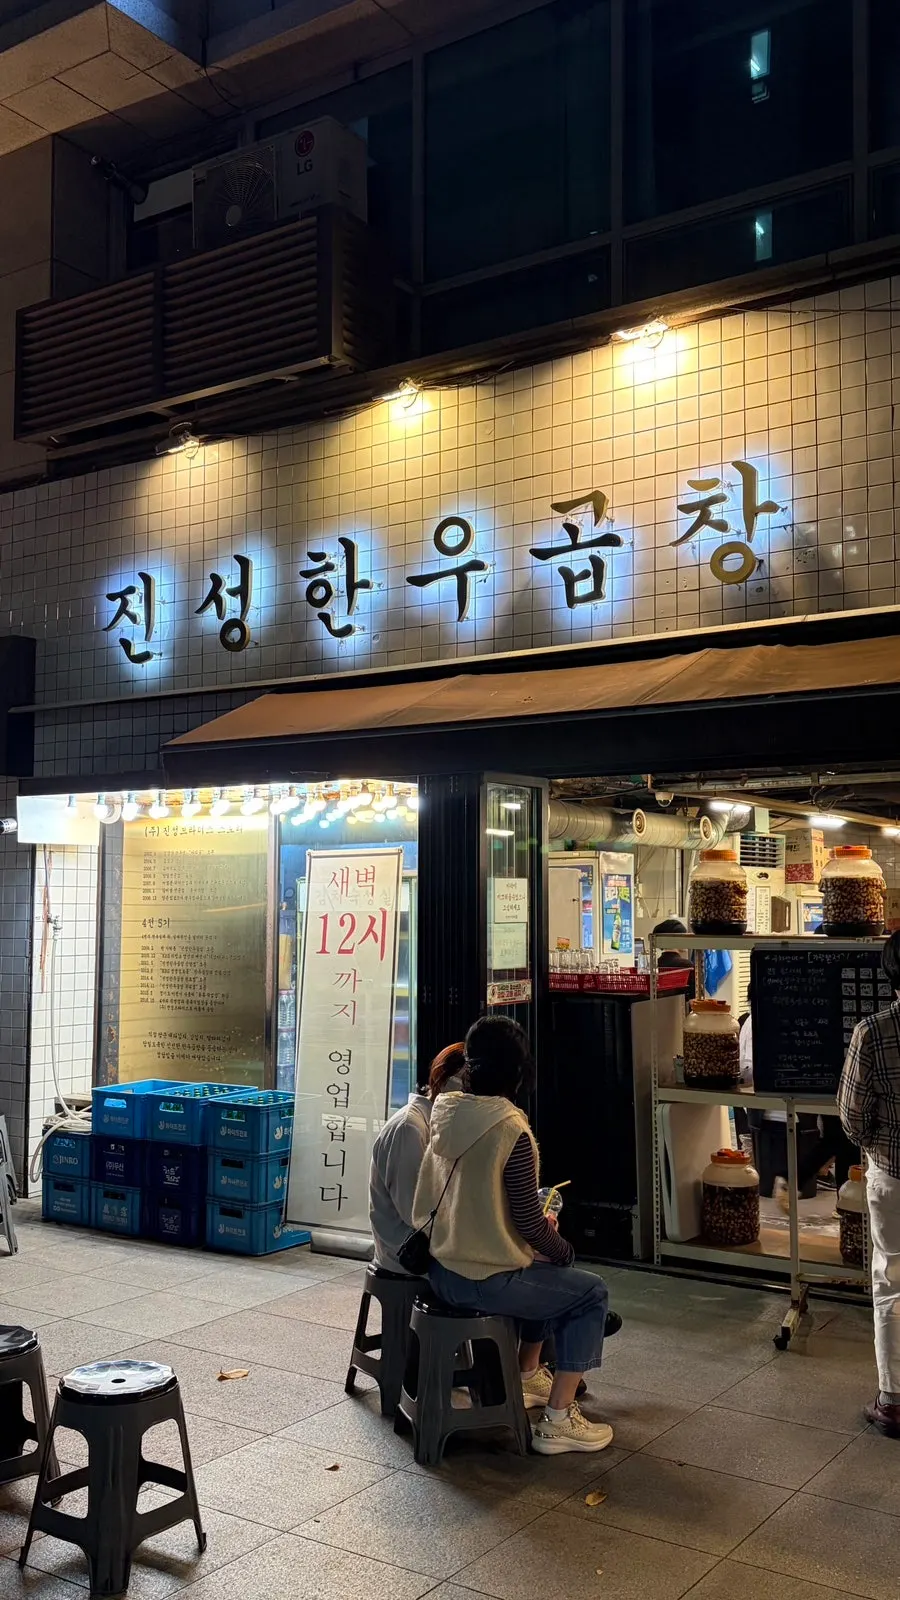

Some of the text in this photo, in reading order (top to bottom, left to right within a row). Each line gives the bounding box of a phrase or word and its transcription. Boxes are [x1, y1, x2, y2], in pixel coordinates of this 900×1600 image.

[297, 159, 313, 175] LG
[103, 460, 783, 666] 진성한우곱창
[327, 865, 376, 898] 새벽
[315, 906, 387, 963] 12시
[330, 967, 363, 1026] 까지
[318, 1048, 353, 1213] 영업합니다
[59, 1155, 79, 1165] JINRO
